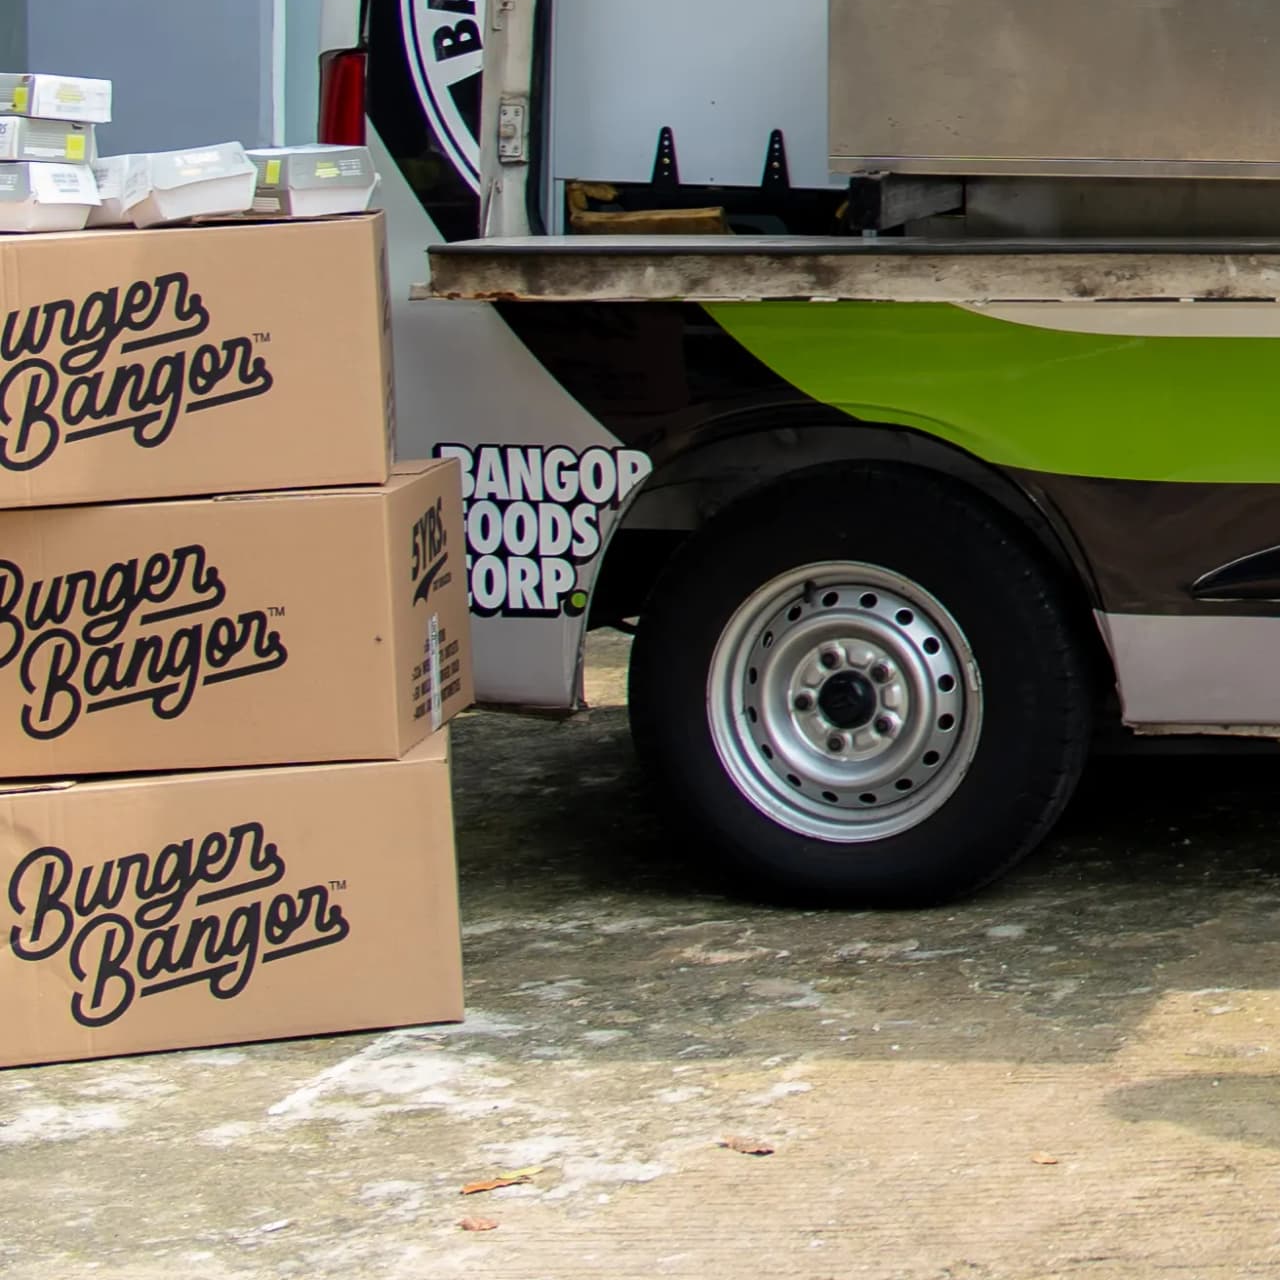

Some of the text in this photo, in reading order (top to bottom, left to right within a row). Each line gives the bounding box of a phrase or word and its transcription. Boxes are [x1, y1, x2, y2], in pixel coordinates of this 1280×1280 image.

[0, 272, 209, 376] urger
[0, 335, 273, 471] Bangor
[412, 496, 447, 581] 5YRS.
[464, 500, 600, 556] OODS
[467, 556, 587, 610] ORP.
[20, 610, 288, 740] Bangor
[8, 822, 285, 962] Burger
[70, 883, 350, 1027] Bangor
